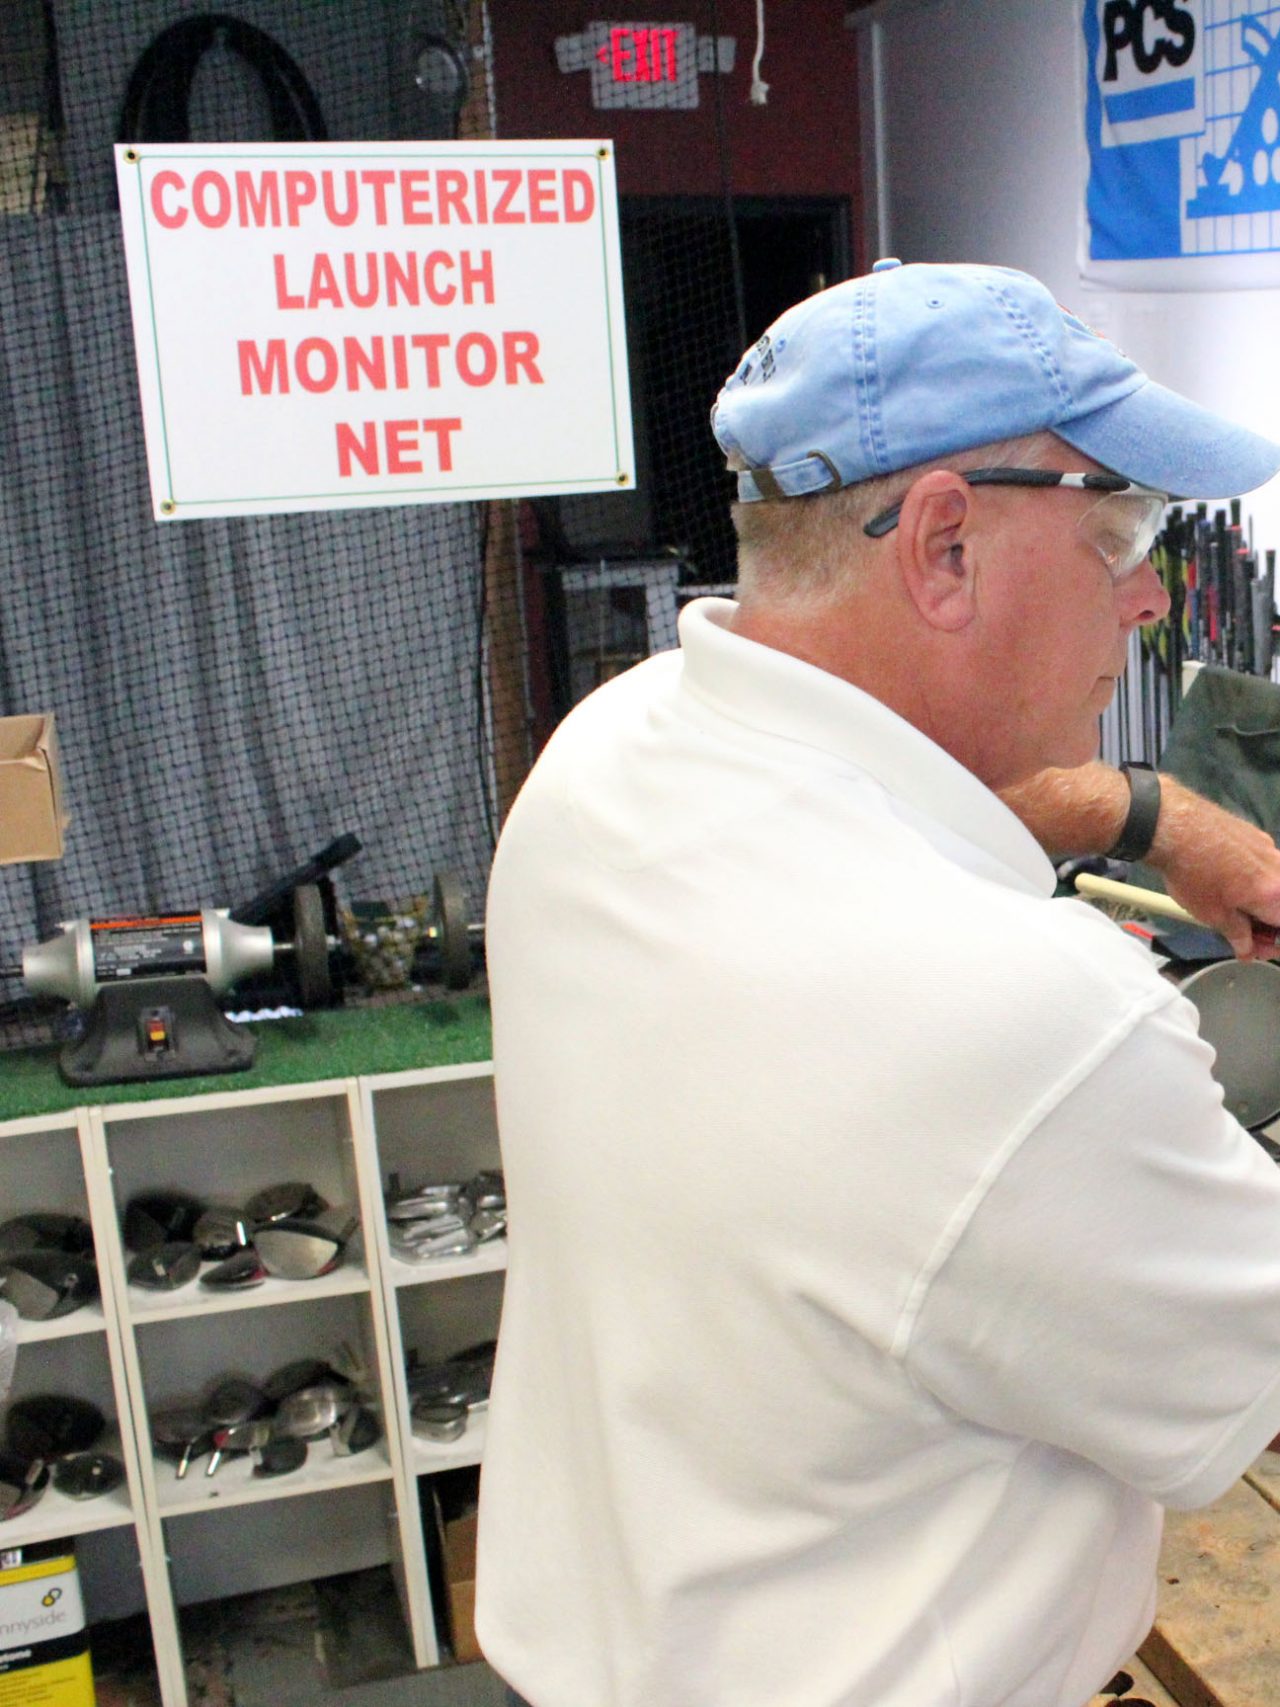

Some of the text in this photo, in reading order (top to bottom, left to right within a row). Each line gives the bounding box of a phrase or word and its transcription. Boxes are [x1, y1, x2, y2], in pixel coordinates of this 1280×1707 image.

[610, 28, 678, 83] EXIT
[1102, 0, 1195, 81] PCS
[150, 169, 596, 230] COMPUTERIZED
[273, 249, 495, 311] LAUNCH
[237, 331, 544, 396] MONITOR
[335, 417, 462, 478] NET
[0, 1609, 66, 1635] nnyside
